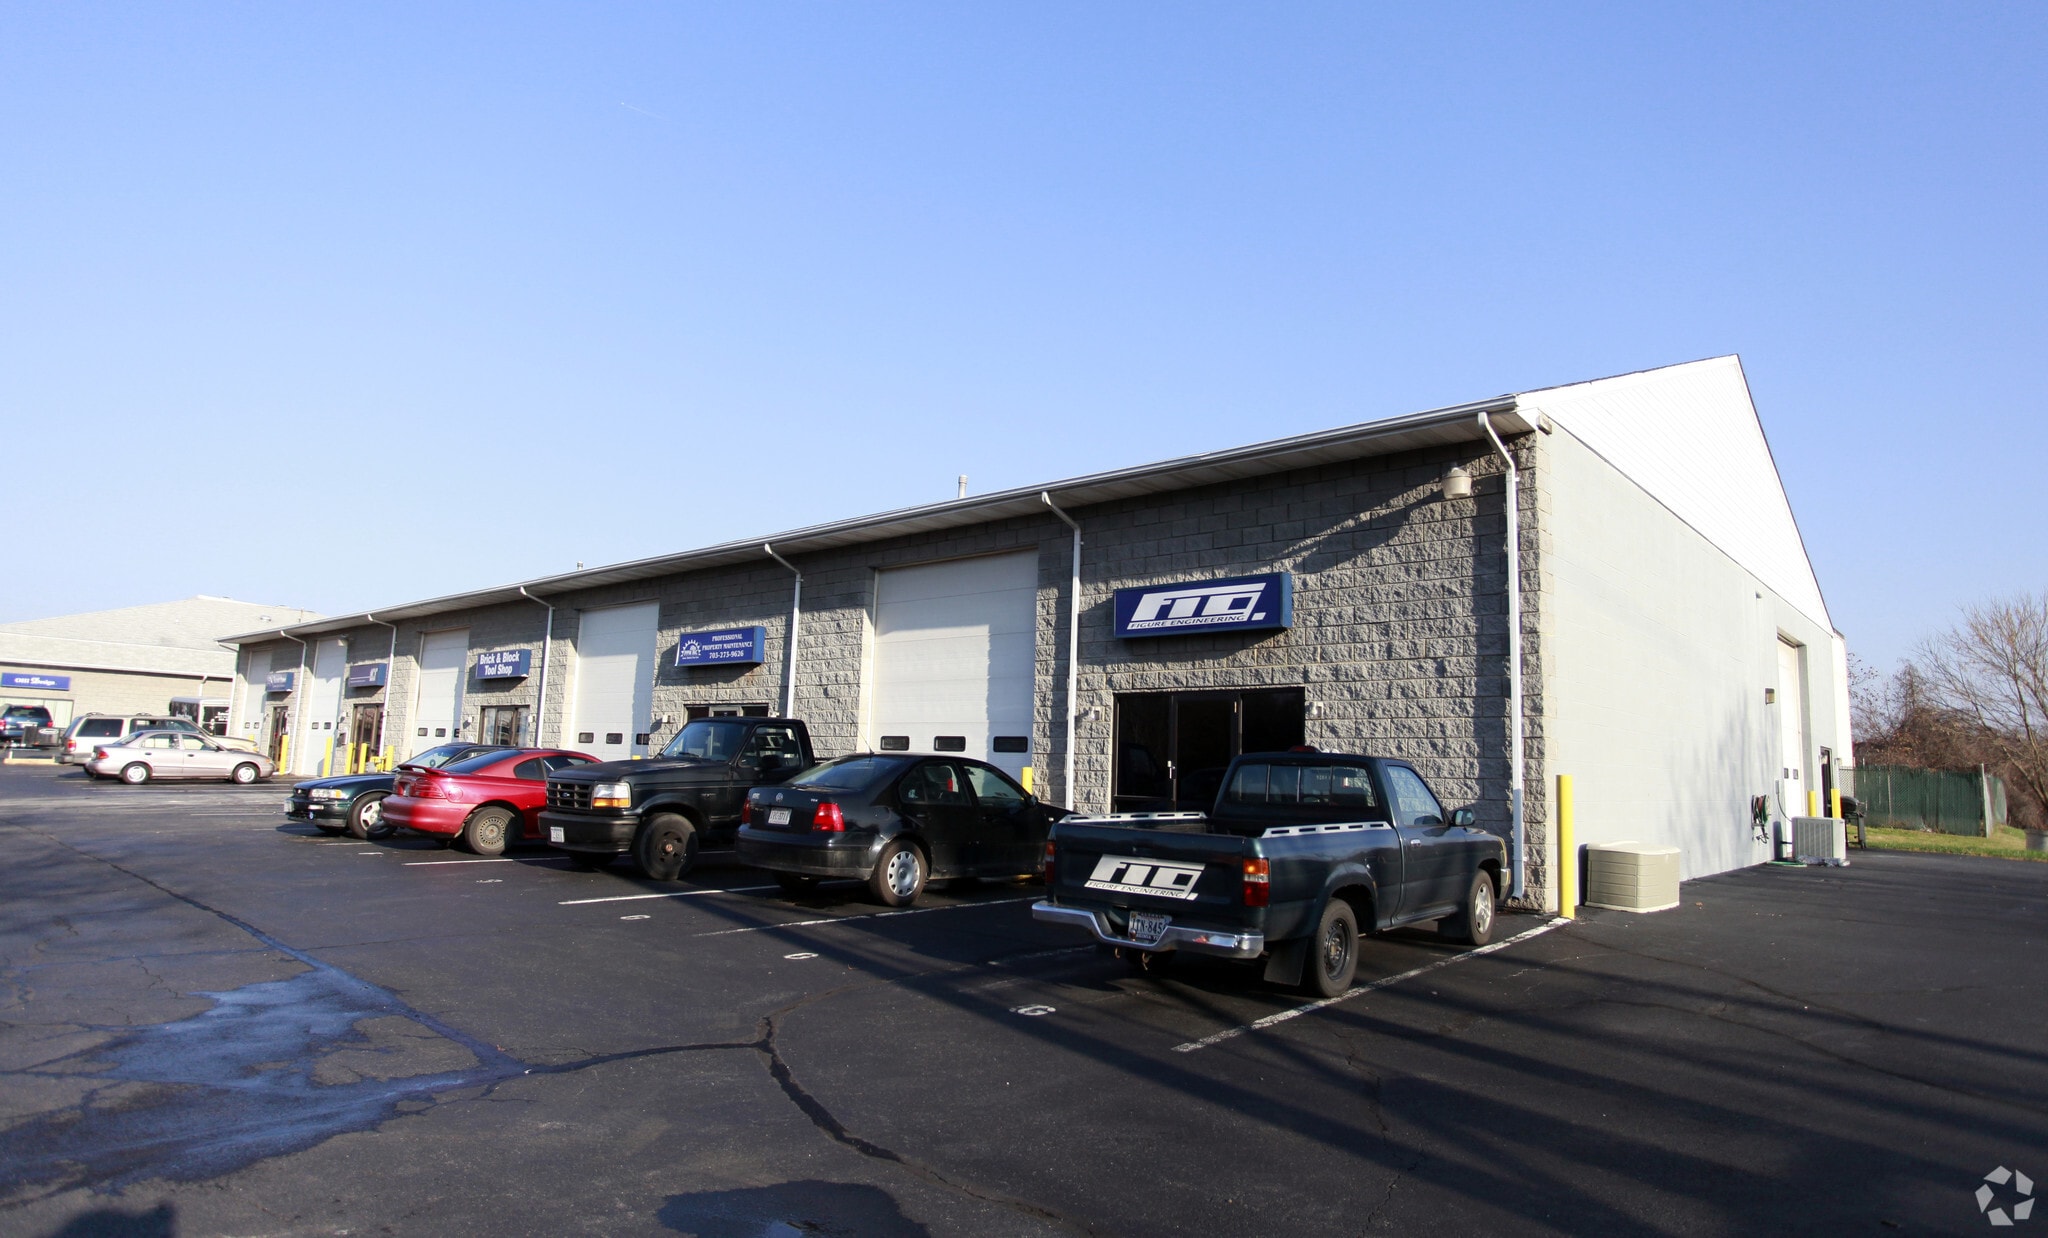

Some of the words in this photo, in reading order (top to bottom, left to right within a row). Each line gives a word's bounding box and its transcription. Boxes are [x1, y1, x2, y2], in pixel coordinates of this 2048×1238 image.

[1129, 620, 1167, 629] FIGURE
[1170, 614, 1246, 626] ENGINEERING
[712, 634, 742, 642] PROFESSIONAL
[723, 641, 753, 649] MAINTENANCE
[480, 654, 495, 664] Brick
[496, 653, 501, 663] &
[502, 651, 520, 663] Block
[485, 665, 497, 675] Tool
[497, 664, 512, 676] Shop
[1088, 881, 1120, 891] FIGURE
[1121, 886, 1183, 898] ENGINEERING
